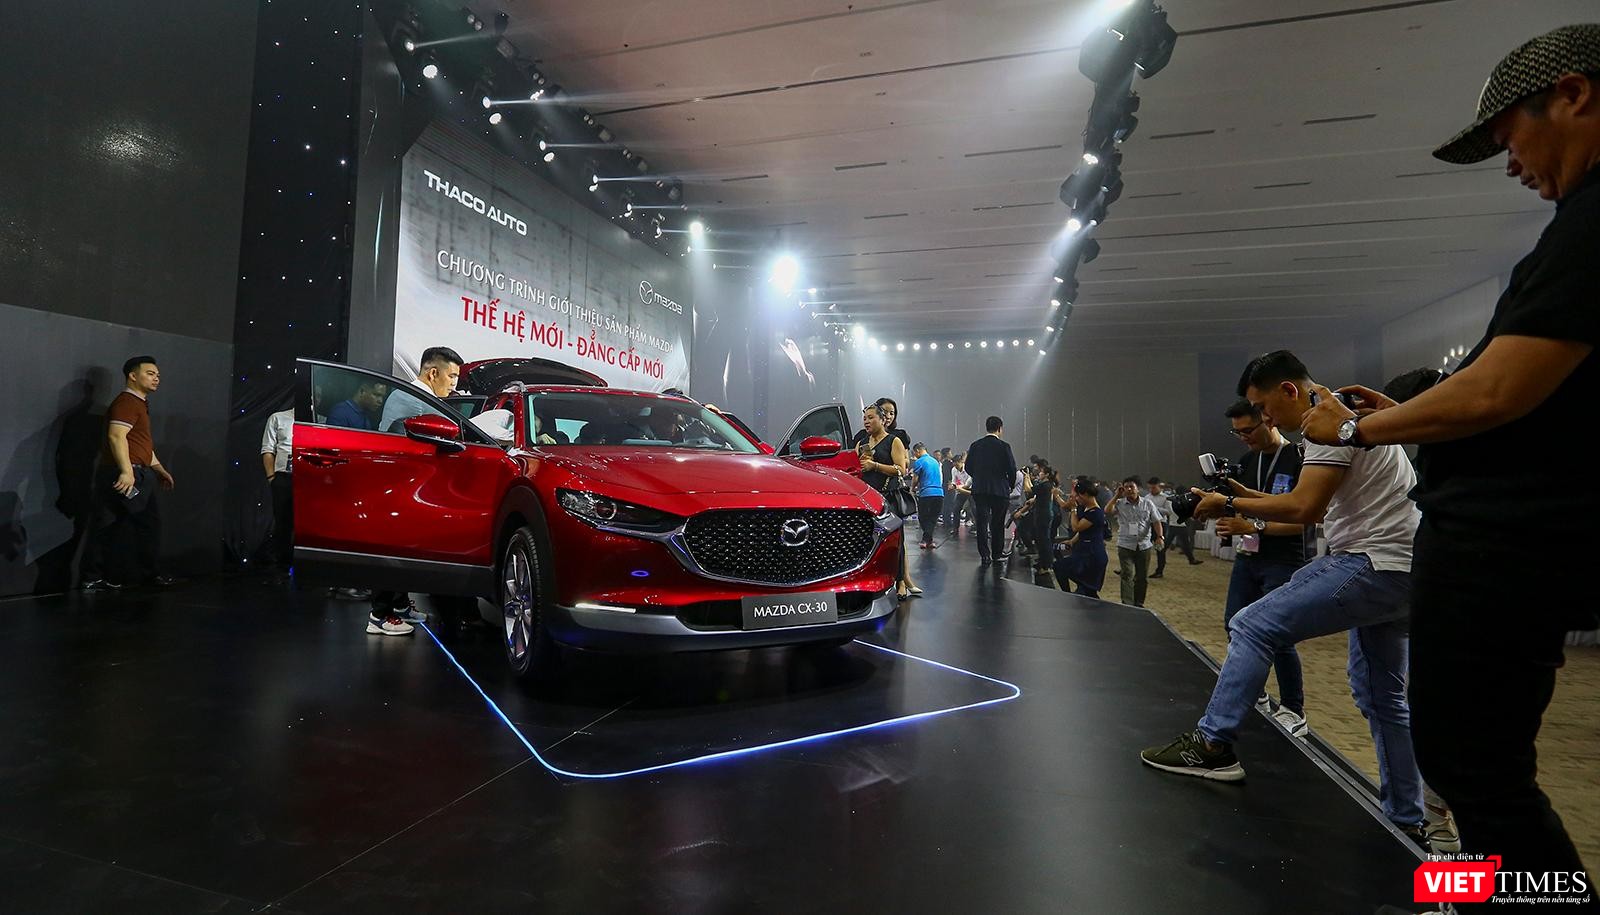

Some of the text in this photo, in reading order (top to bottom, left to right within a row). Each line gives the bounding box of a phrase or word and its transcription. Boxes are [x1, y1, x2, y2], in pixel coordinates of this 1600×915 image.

[424, 169, 528, 236] THACO AUTO
[437, 250, 506, 290] CHƯƠNG
[509, 278, 546, 306] TRÌNH
[549, 294, 573, 316] GIỚI
[575, 305, 603, 328] THIỆU
[605, 314, 622, 334] SẢN
[648, 335, 674, 354] MAZDA
[461, 296, 501, 330] THẾ
[503, 310, 526, 343] HỆ
[530, 321, 564, 350] MỚI
[576, 328, 615, 365] ĐẲNG
[618, 346, 641, 372] CẤP
[643, 358, 664, 380] MỚI
[754, 601, 828, 618] MAZDA CX-30
